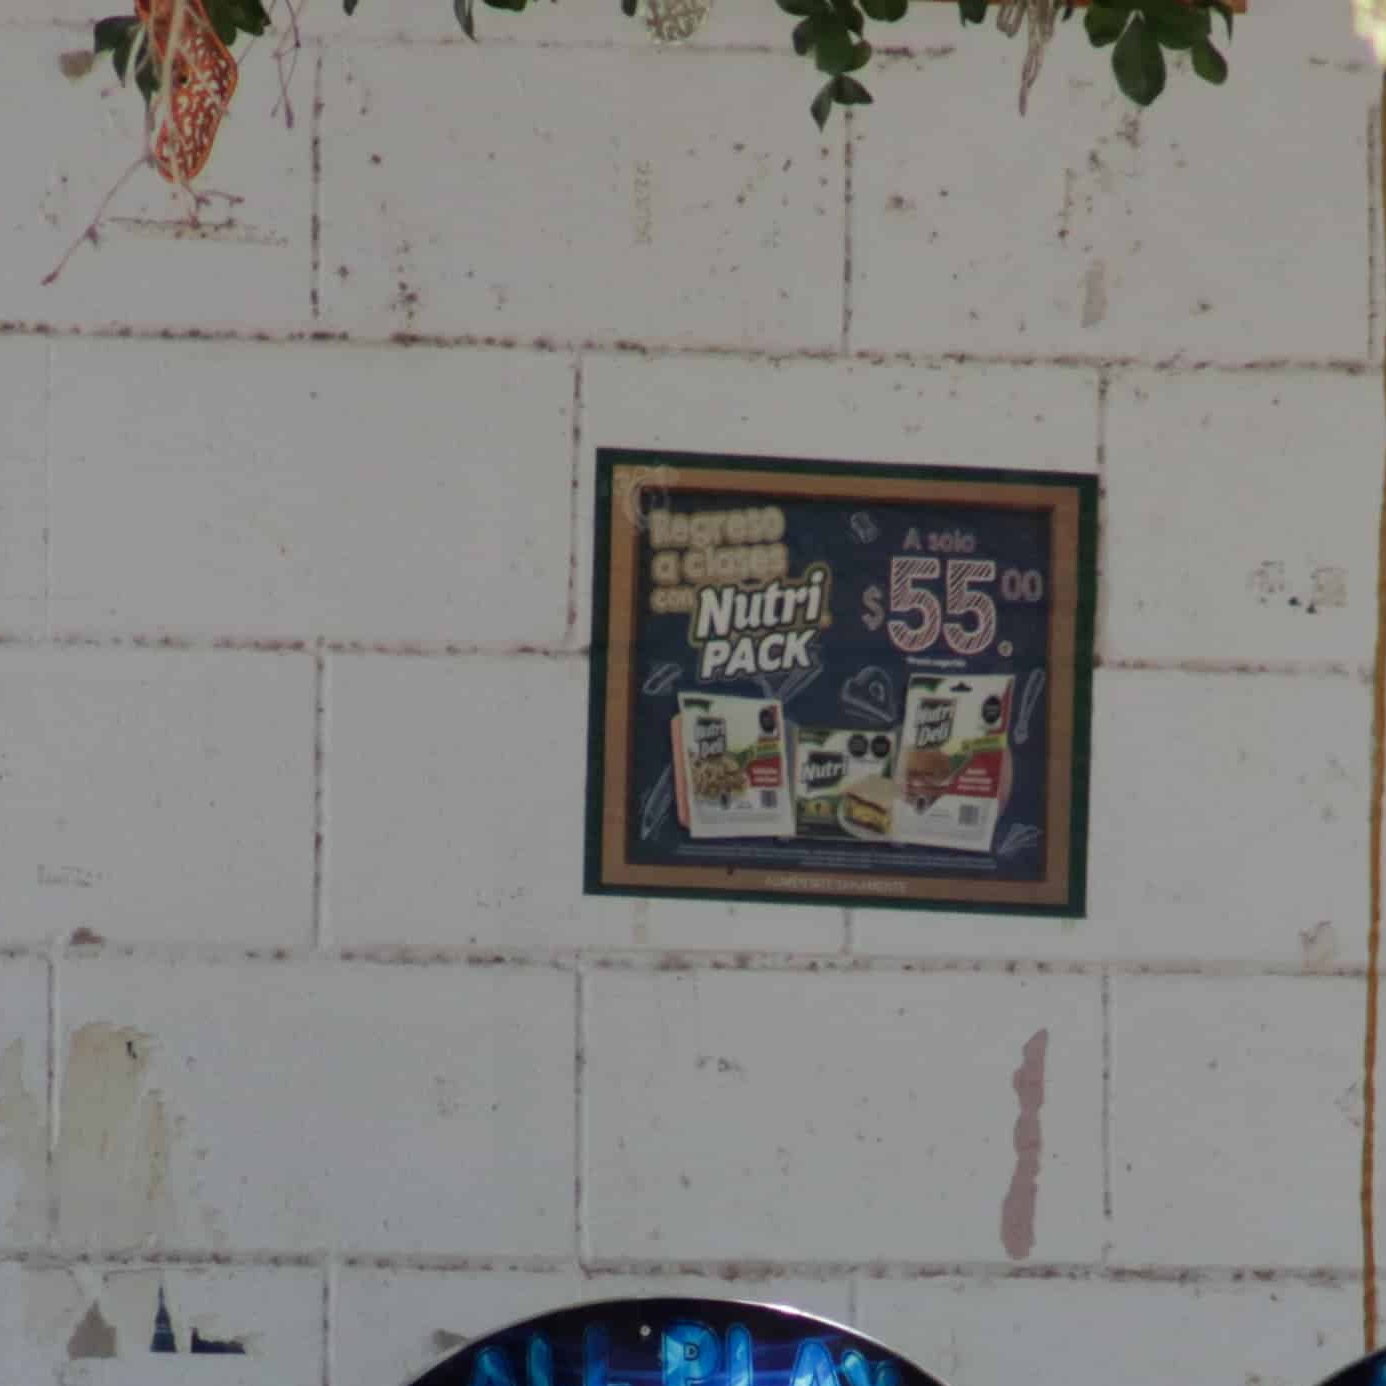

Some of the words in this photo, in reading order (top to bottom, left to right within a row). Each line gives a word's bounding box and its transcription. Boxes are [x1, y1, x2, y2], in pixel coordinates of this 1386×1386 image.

[902, 528, 920, 550] A
[696, 571, 825, 638] Nutri
[701, 629, 815, 678] PACK
